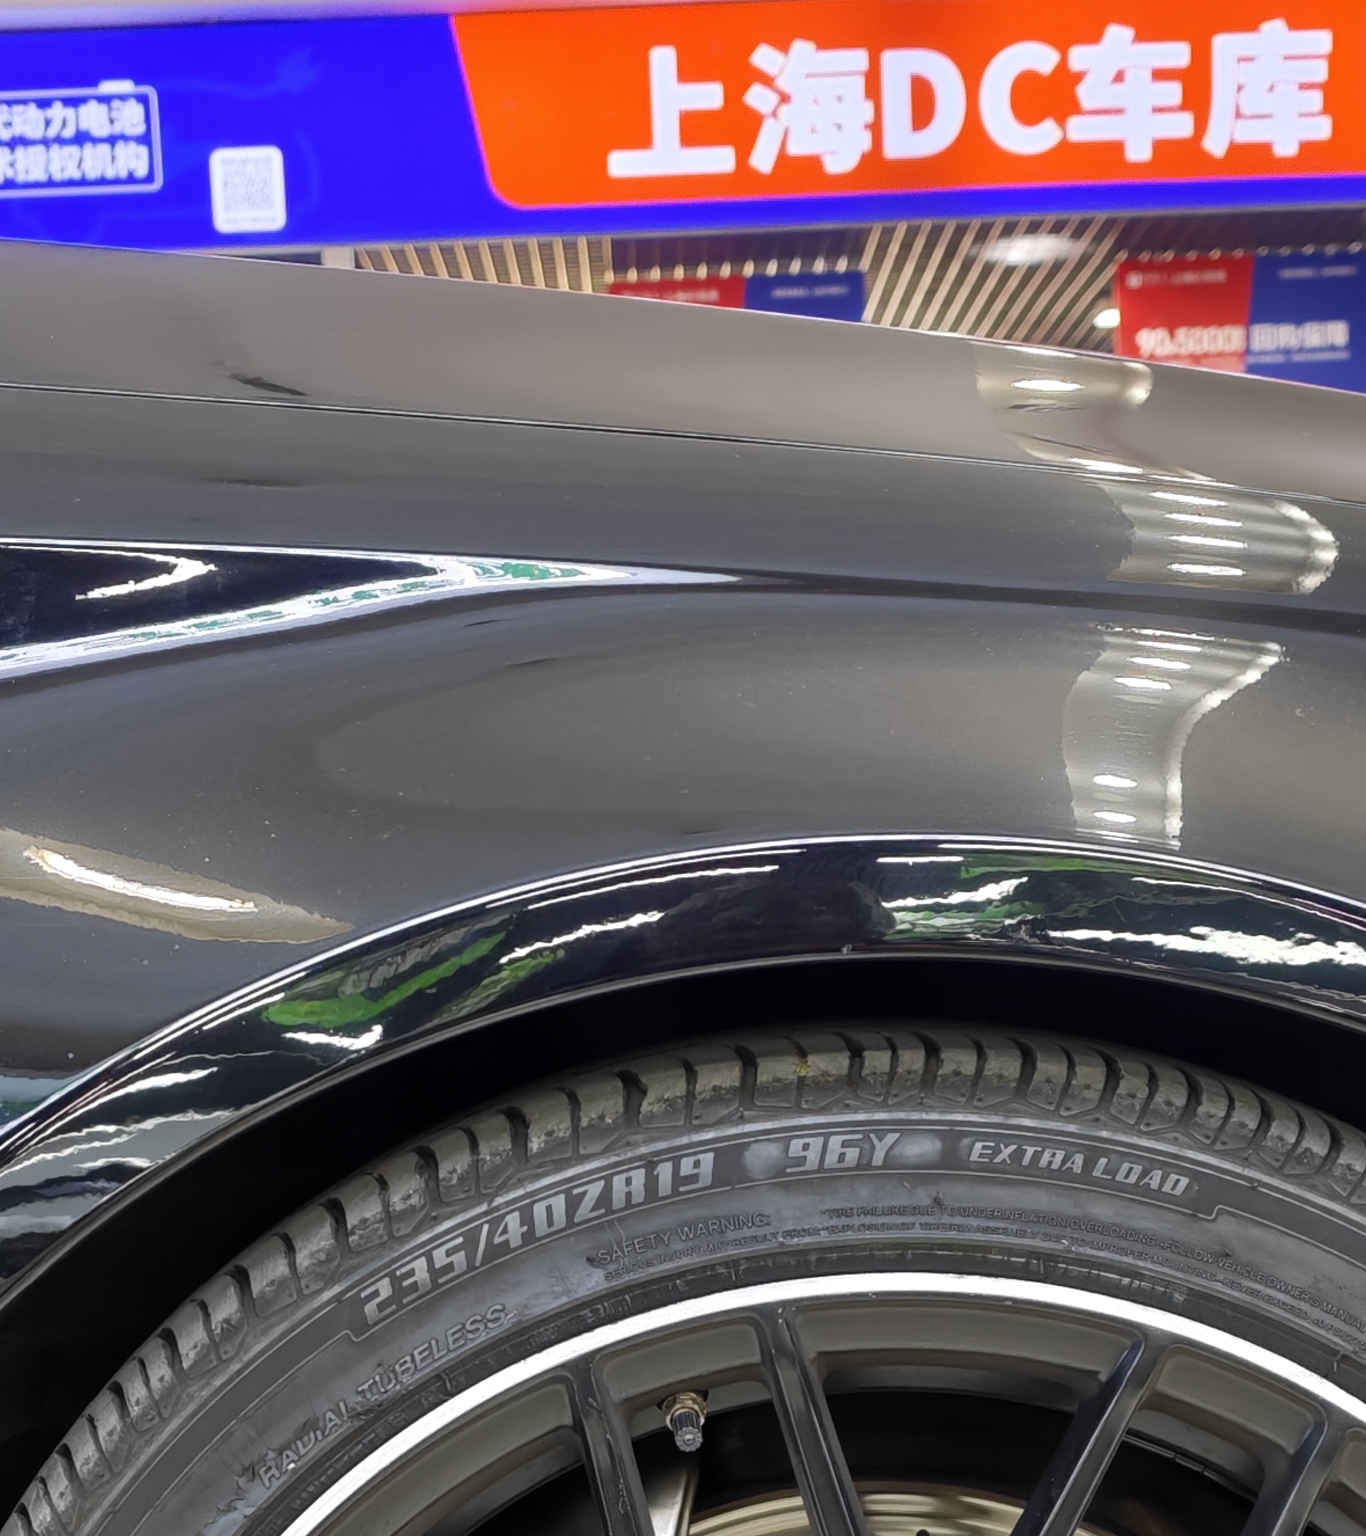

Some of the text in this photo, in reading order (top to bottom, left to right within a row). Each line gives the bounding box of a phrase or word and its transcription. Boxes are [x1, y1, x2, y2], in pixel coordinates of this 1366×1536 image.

[607, 19, 1333, 179] 上海DC车库
[359, 1132, 1192, 1325] 235/40ZR19 96Y EXTRA LOAD
[596, 1232, 672, 1267] SAFETY
[938, 1204, 957, 1217] TO
[1212, 1255, 1267, 1285] VEHICLE
[356, 1303, 510, 1403] TUBELESS
